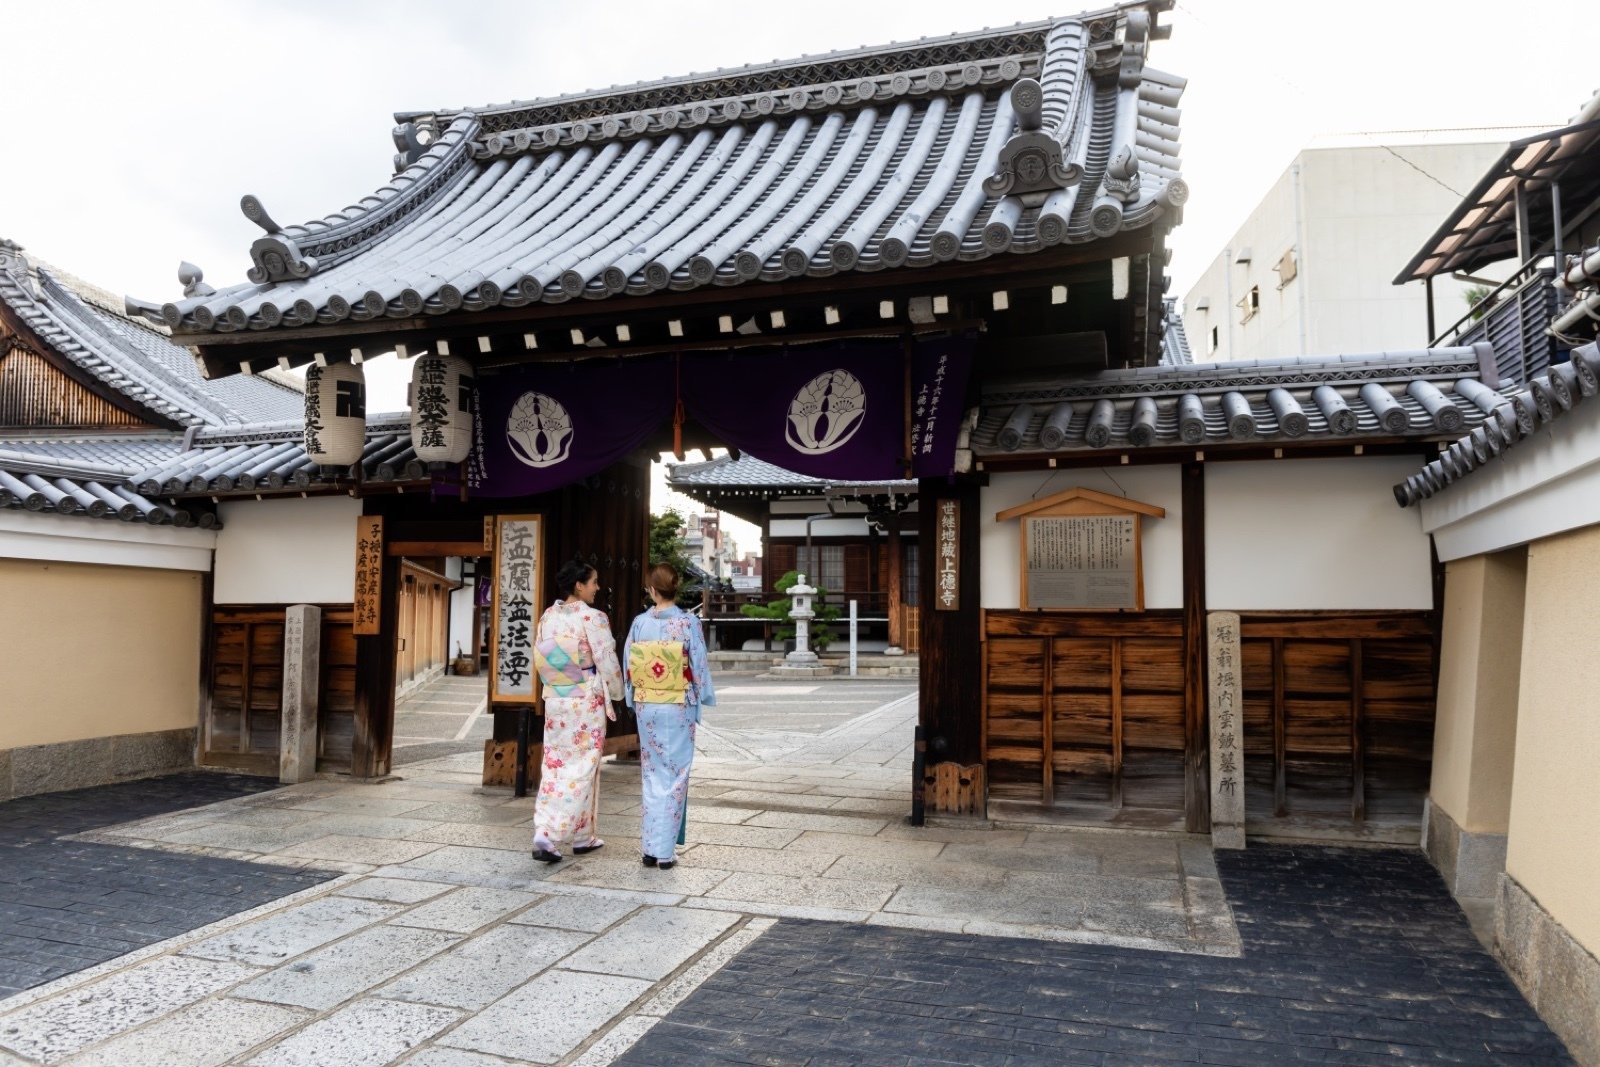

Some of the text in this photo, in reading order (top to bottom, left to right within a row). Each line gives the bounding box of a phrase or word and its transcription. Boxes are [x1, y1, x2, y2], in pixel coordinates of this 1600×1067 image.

[367, 524, 381, 624] 子授け安産の寺
